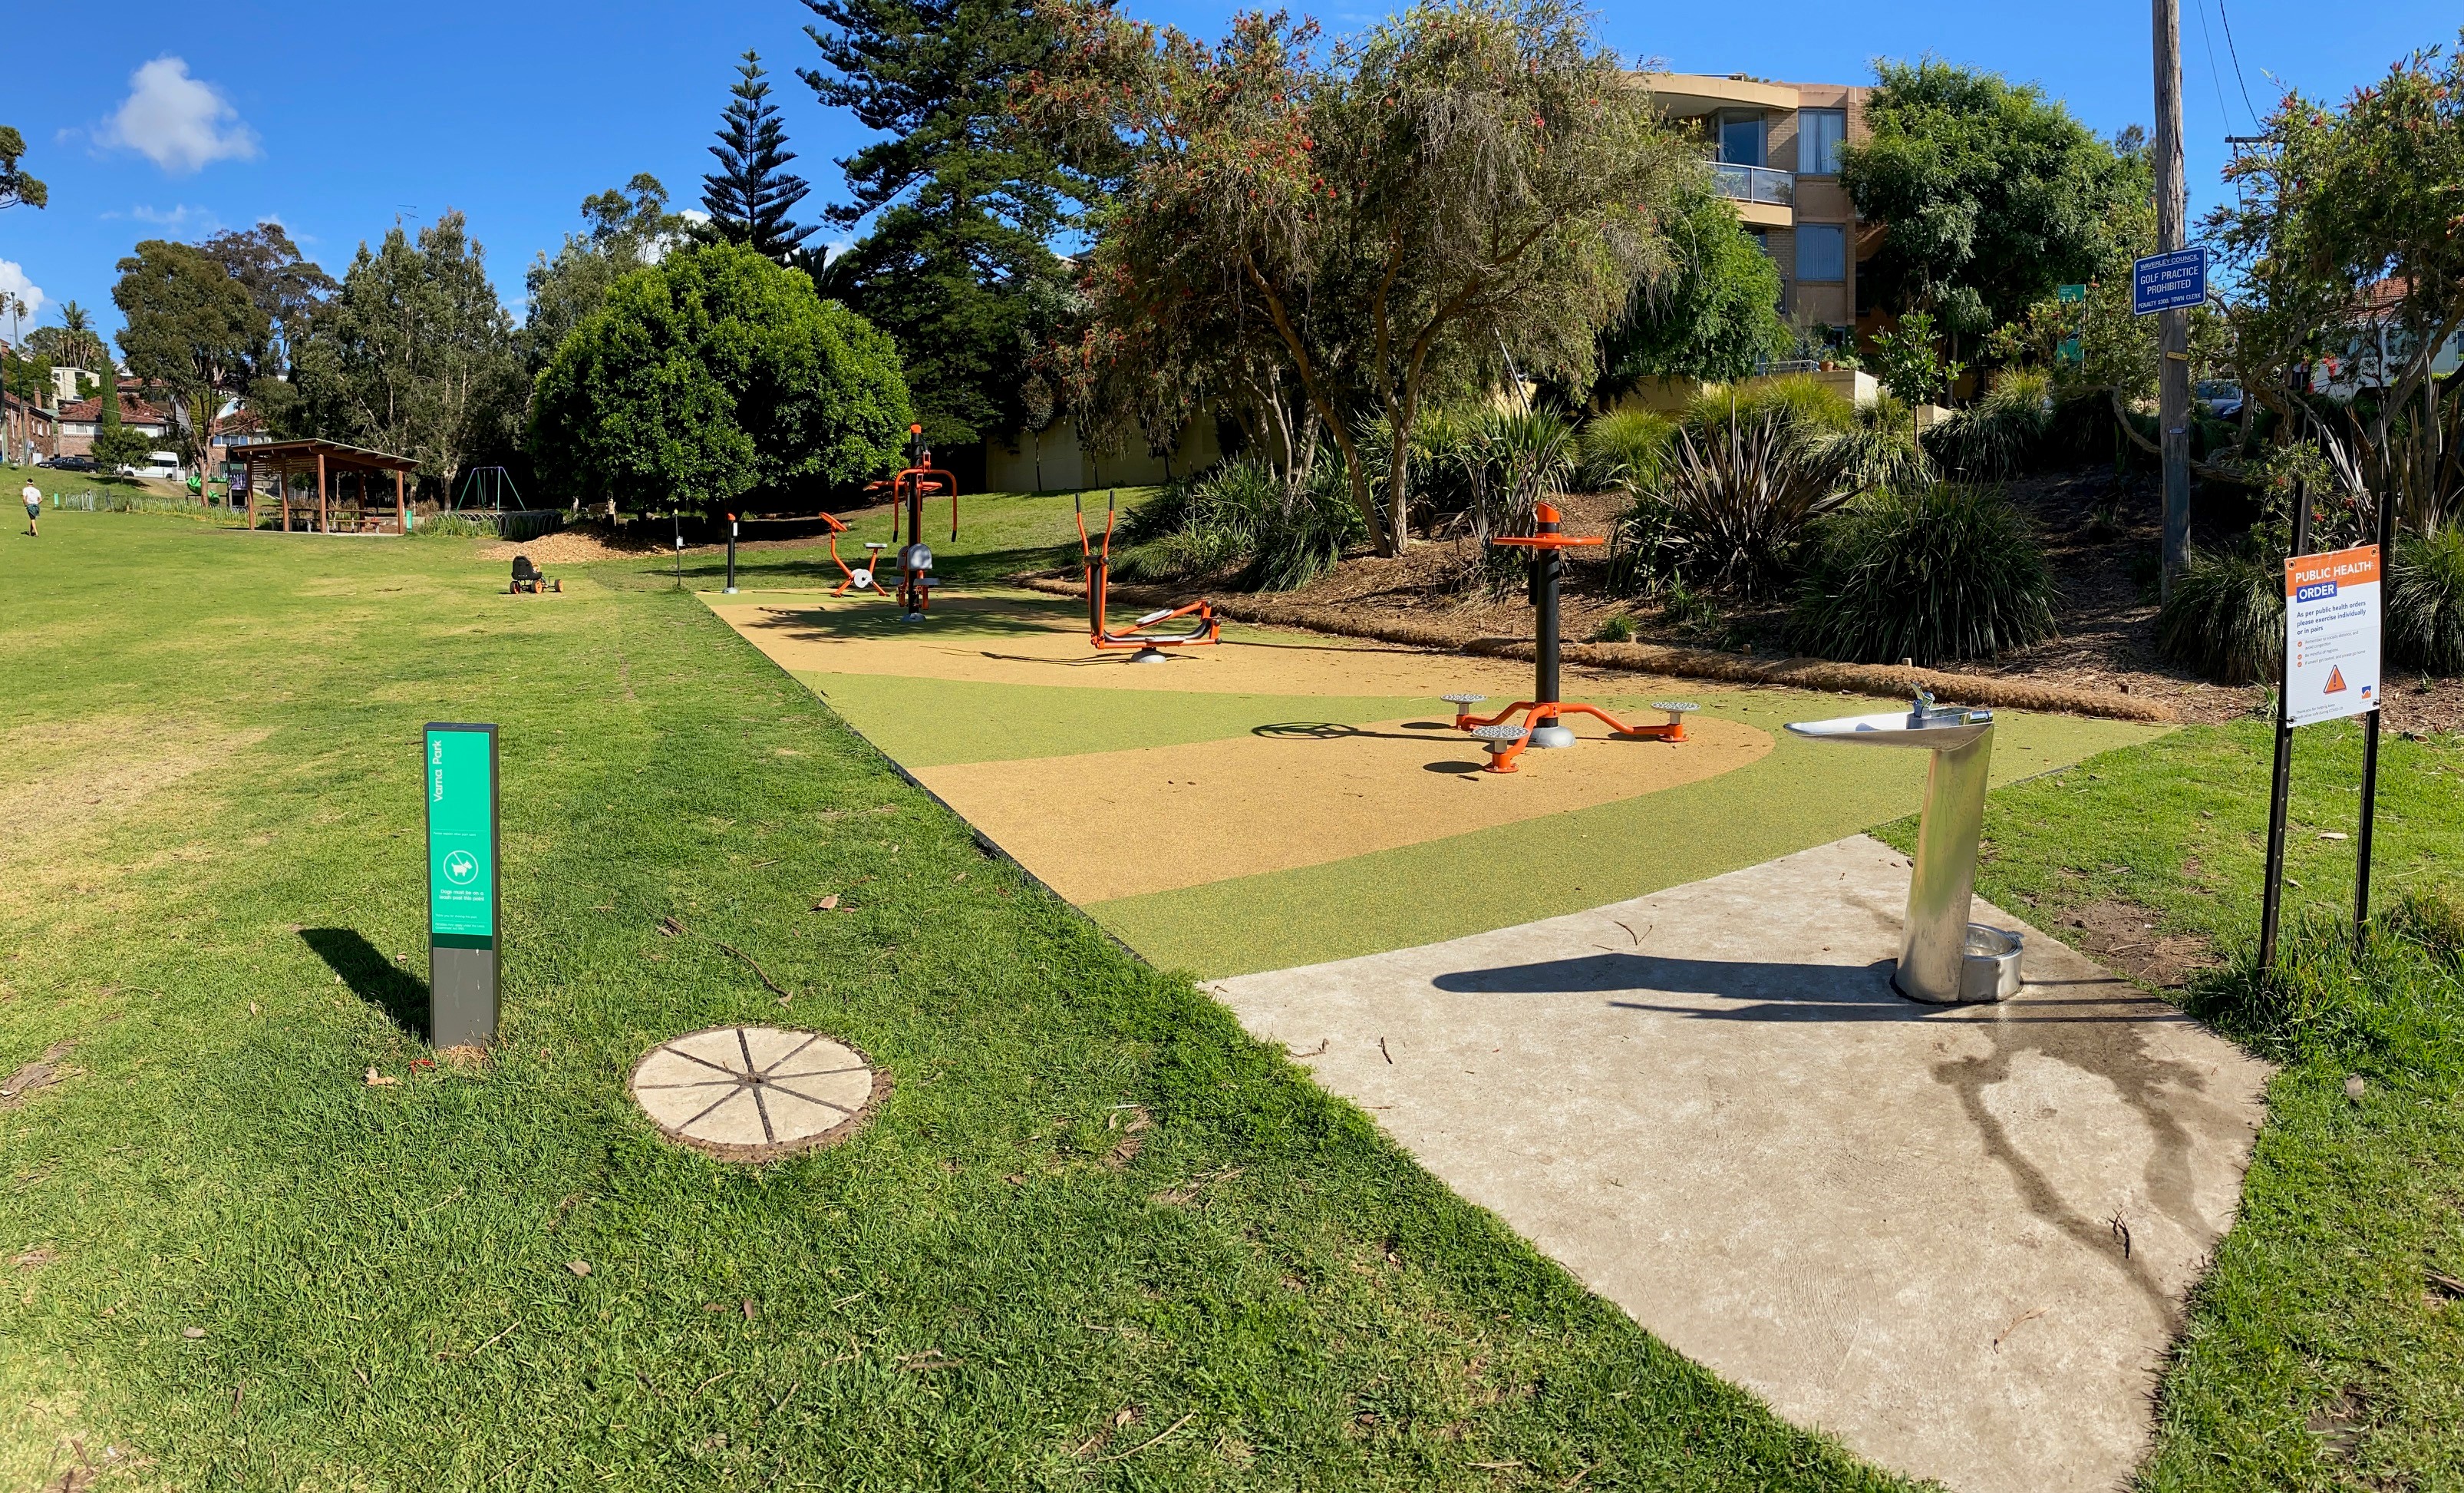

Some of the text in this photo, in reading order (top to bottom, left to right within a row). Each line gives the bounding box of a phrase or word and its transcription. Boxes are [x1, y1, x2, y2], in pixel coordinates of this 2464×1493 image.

[2140, 254, 2198, 269] WAVERLEY COUNCIL
[2141, 266, 2198, 285] GOLF PRACTICE
[2147, 279, 2191, 295] PROHIBITED
[2138, 300, 2156, 309] PENALTY
[2296, 560, 2371, 583] PUBLIC HEALTH
[2299, 584, 2334, 600] ORDER
[2315, 607, 2331, 616] public
[2337, 609, 2366, 619] individually
[2311, 626, 2324, 634] pairs
[432, 740, 443, 802] Varna Park
